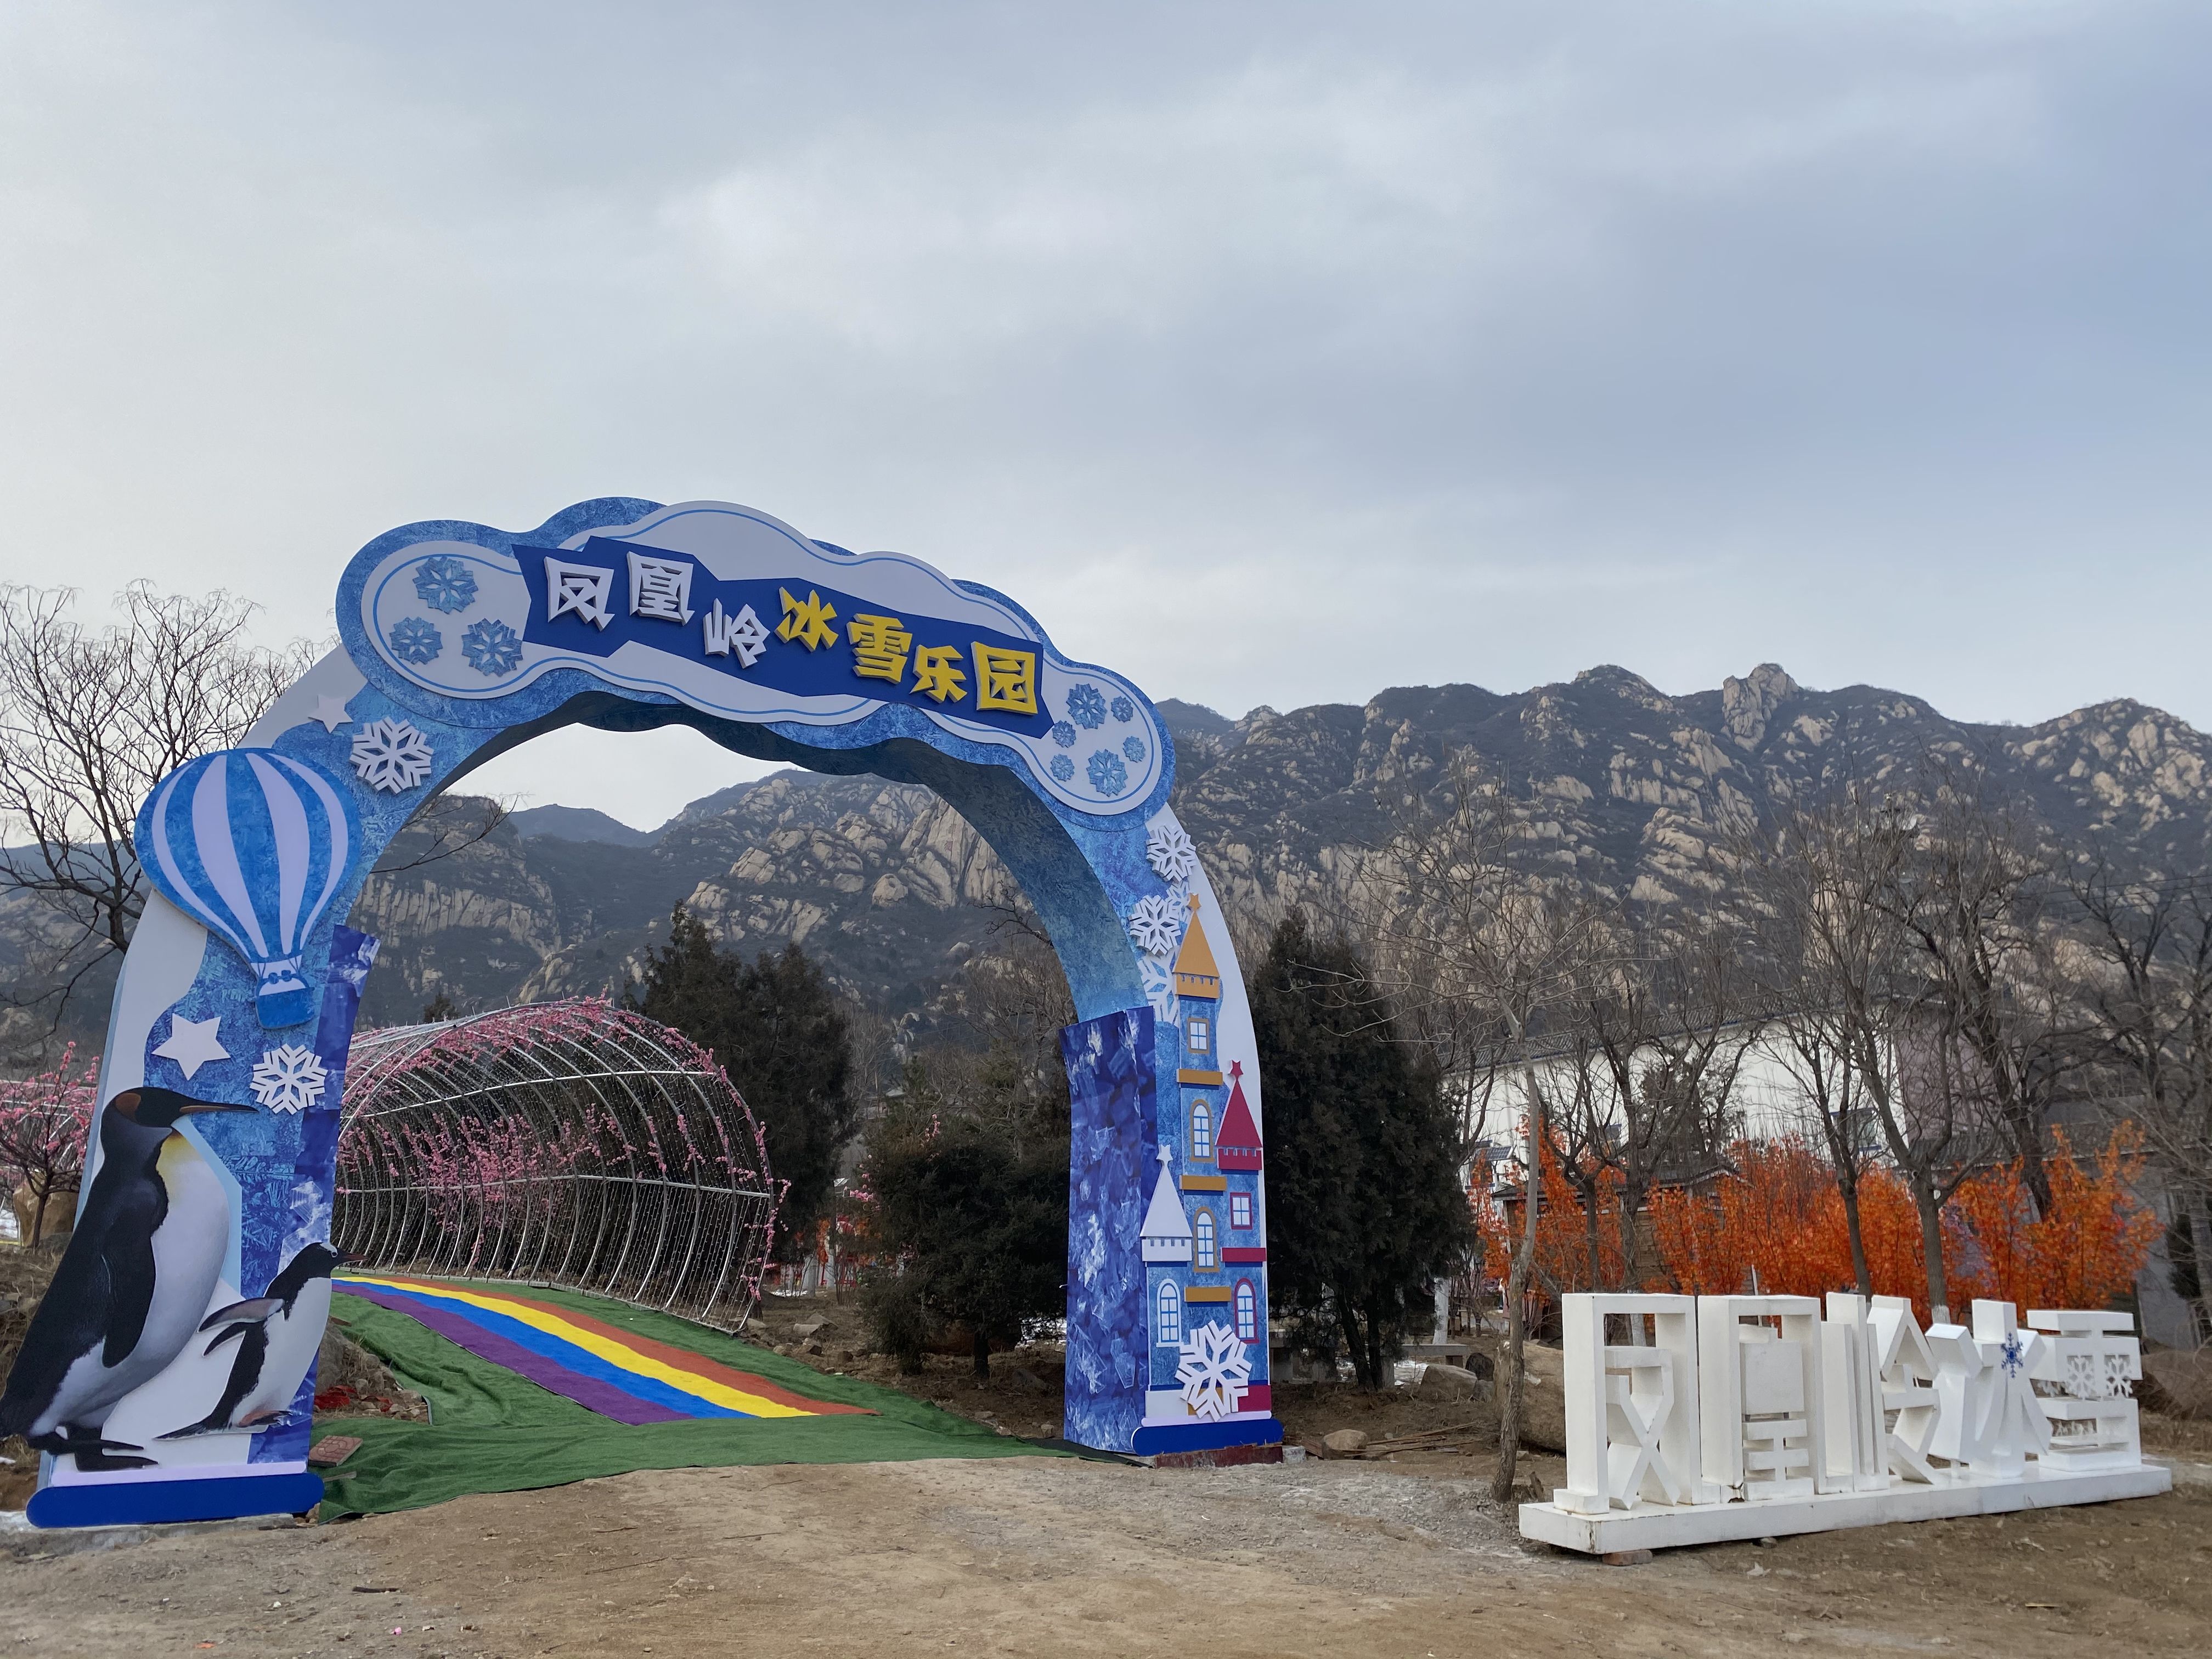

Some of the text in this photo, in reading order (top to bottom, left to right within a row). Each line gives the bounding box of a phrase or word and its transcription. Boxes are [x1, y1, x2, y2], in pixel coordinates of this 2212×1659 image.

[544, 551, 1038, 715] 凤凰岭冰雪乐园
[1554, 1291, 2143, 1514] 凤凰岭冰雪
